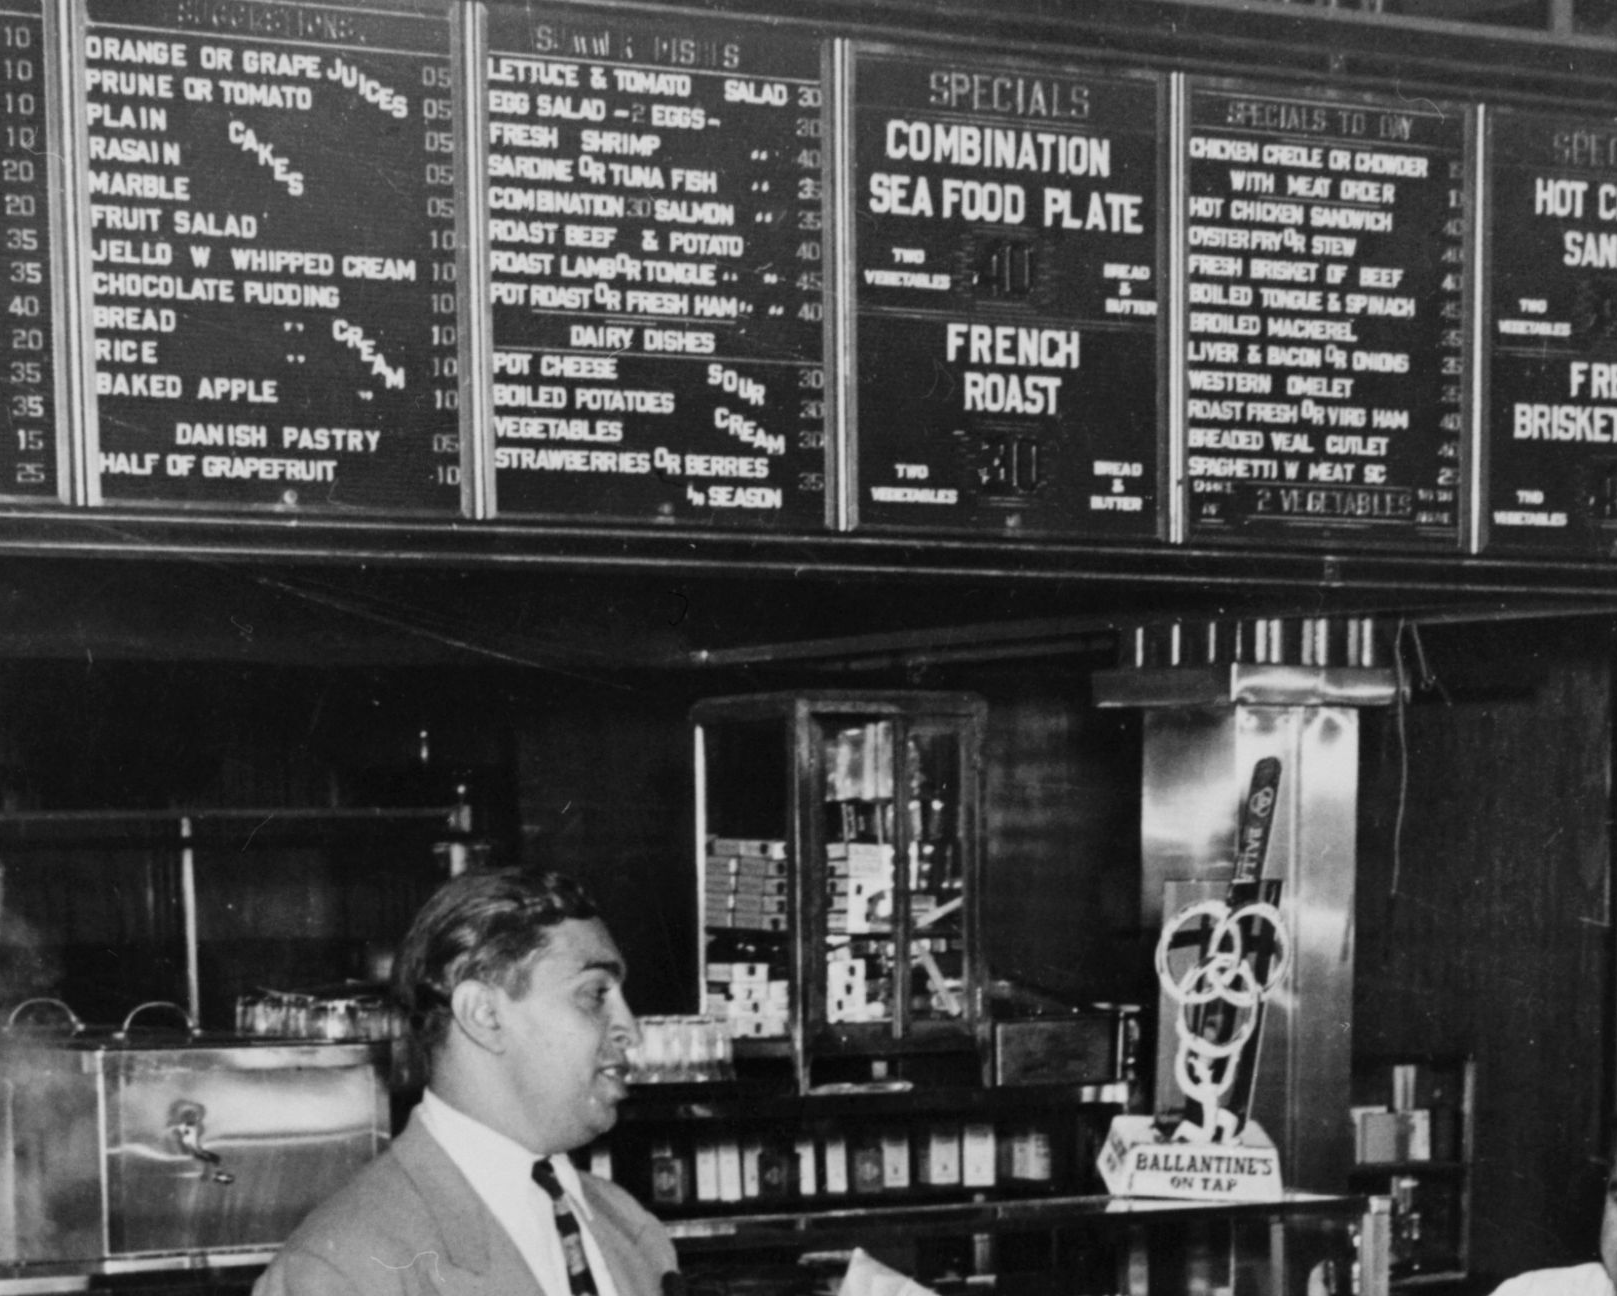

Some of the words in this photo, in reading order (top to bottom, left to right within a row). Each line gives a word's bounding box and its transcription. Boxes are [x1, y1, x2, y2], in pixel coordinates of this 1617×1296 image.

[5, 26, 30, 48] 10
[5, 60, 32, 81] 10
[85, 35, 187, 67] ORANGE
[200, 47, 233, 71] OR
[242, 50, 321, 78] GRAPE
[327, 58, 407, 118] JUICES
[422, 66, 451, 87] 05
[488, 57, 579, 89] LETTUCE
[590, 67, 607, 90] &
[612, 69, 692, 98] TOMATO
[725, 79, 788, 107] SALAD
[798, 86, 821, 108] 30
[929, 71, 1090, 119] SPECIALS
[87, 103, 167, 131] PLAIN
[89, 137, 180, 166] RASAIN
[489, 124, 559, 149] FRESH
[581, 129, 661, 157] SHRIMP
[886, 119, 1110, 178] COMBINATION
[3, 160, 33, 182] 20
[229, 121, 304, 196] CAKES
[1190, 137, 1258, 163] CHICKEN
[1263, 143, 1323, 170] CREOLE
[1329, 149, 1351, 171] OR
[1355, 152, 1429, 178] CHOWDER
[88, 170, 189, 200] MARBLE
[1535, 177, 1588, 219] HOT
[5, 194, 35, 217] 20
[869, 175, 932, 218] SEA
[942, 179, 1025, 224] FOOD
[1044, 188, 1144, 234] PLATE
[1190, 197, 1224, 219] HOT
[1230, 201, 1303, 227] CHICKEN
[1310, 206, 1393, 232] SANDWICH
[91, 204, 161, 232] FRUIT
[174, 210, 257, 239] SALAD
[488, 219, 558, 246] ROAST
[565, 224, 617, 249] BEEF
[642, 229, 659, 252] &
[669, 232, 744, 257] POTATO
[892, 247, 925, 264] TWO
[9, 261, 41, 284] 35
[864, 269, 951, 290] VEGETABLES
[1103, 263, 1150, 281] BREAD
[8, 295, 39, 317] 40
[92, 273, 234, 302] CHOCOLATE
[243, 281, 340, 309] PUDDING
[432, 294, 455, 314] 10
[1105, 298, 1157, 315] BUTTER
[570, 324, 634, 350] DAIRY
[644, 328, 715, 354] DISHES
[1189, 312, 1260, 336] BROILED
[1267, 317, 1358, 342] MACKEREL
[333, 319, 405, 389] CREAM
[947, 323, 1079, 369] FRENCH
[10, 361, 41, 384] 35
[95, 372, 181, 398] BAKED
[197, 377, 278, 402] APPLE
[492, 353, 533, 376] POT
[540, 355, 618, 380] CHEESE
[707, 364, 765, 407] SOUR
[1189, 370, 1272, 393] WESTERN
[1287, 376, 1354, 398] OMELET
[492, 384, 567, 410] BOILED
[574, 387, 675, 415] POTATOES
[964, 372, 1062, 415] ROAST
[18, 428, 43, 451] 15
[176, 423, 267, 447] DANISH
[283, 426, 380, 452] PASTRY
[494, 416, 623, 443] VEGETABLES
[714, 406, 785, 456] CREAM
[1281, 489, 1412, 516] VEGETABLES
[1135, 1151, 1273, 1176] BALLANTINE'S
[1170, 1176, 1195, 1191] ON
[1200, 1177, 1239, 1193] TAP
